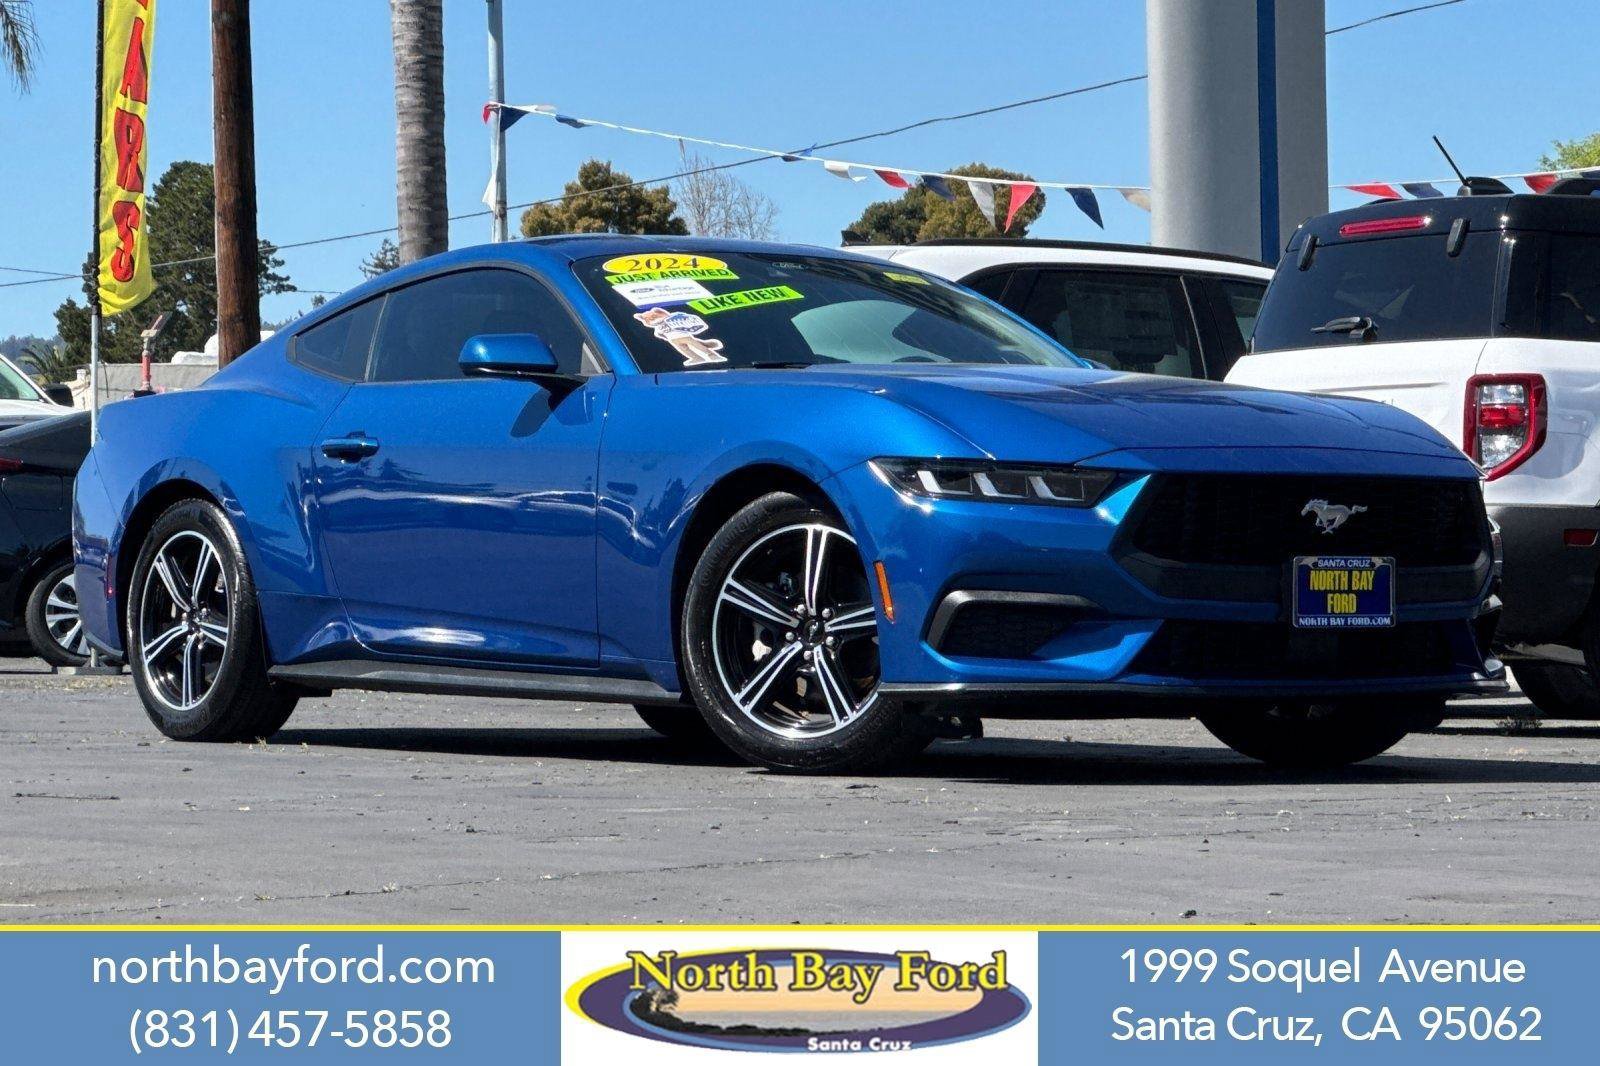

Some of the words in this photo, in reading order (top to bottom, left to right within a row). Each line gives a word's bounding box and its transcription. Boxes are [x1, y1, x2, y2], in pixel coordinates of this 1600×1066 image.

[110, 0, 149, 283] ARS
[625, 257, 700, 272] 2024
[614, 272, 655, 284] JUST
[660, 269, 731, 279] ARRIVED
[700, 294, 742, 310] LIKE
[747, 286, 785, 302] NEW
[1317, 559, 1346, 568] SANTA
[1347, 559, 1371, 568] CRUZ
[1309, 570, 1349, 591] NORTH
[1351, 570, 1375, 591] BAY
[1327, 593, 1357, 614] FORD
[1299, 617, 1328, 626] NORTH
[1329, 617, 1345, 626] BAY
[1347, 616, 1391, 626] FORD.COM
